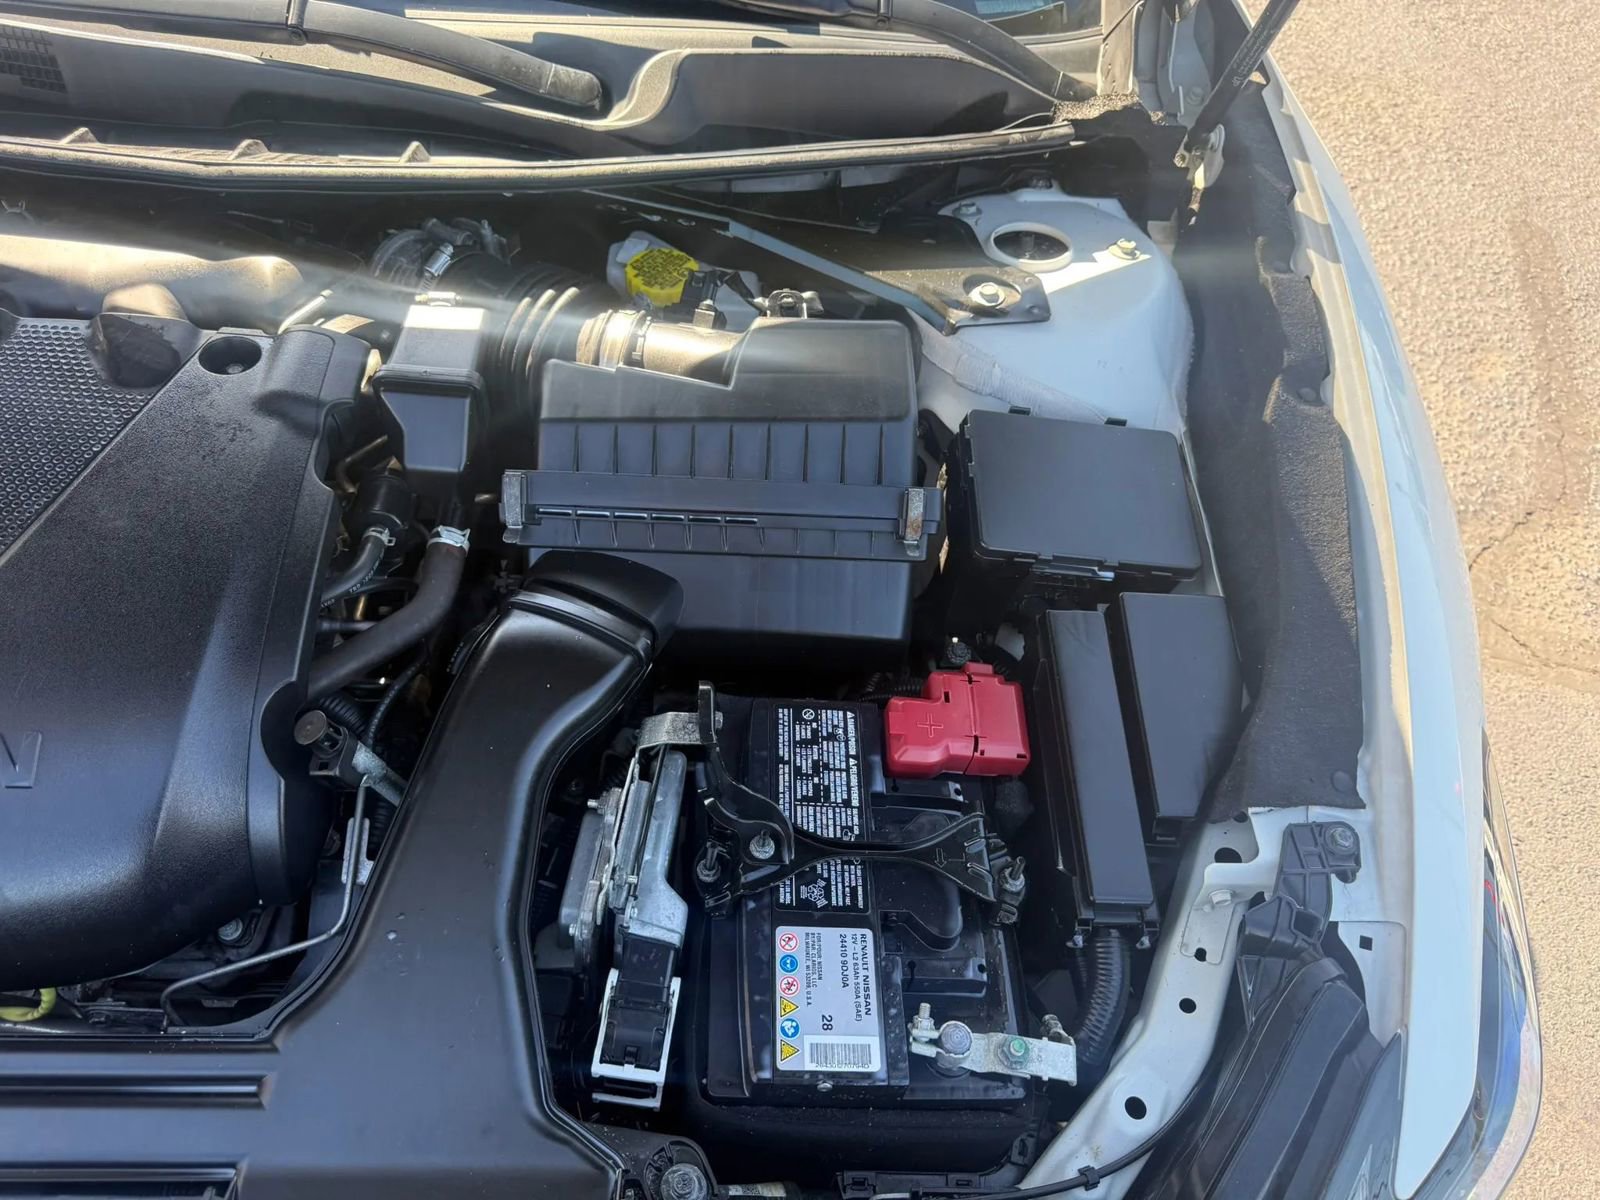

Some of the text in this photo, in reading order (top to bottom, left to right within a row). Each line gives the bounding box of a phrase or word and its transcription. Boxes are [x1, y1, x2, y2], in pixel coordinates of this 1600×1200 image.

[840, 934, 849, 988] 24410 9DJ0A
[852, 952, 858, 960] L2
[860, 934, 871, 1016] RENAULT NISSAN
[854, 1001, 862, 1021] (SAE)
[822, 1014, 833, 1031] 28
